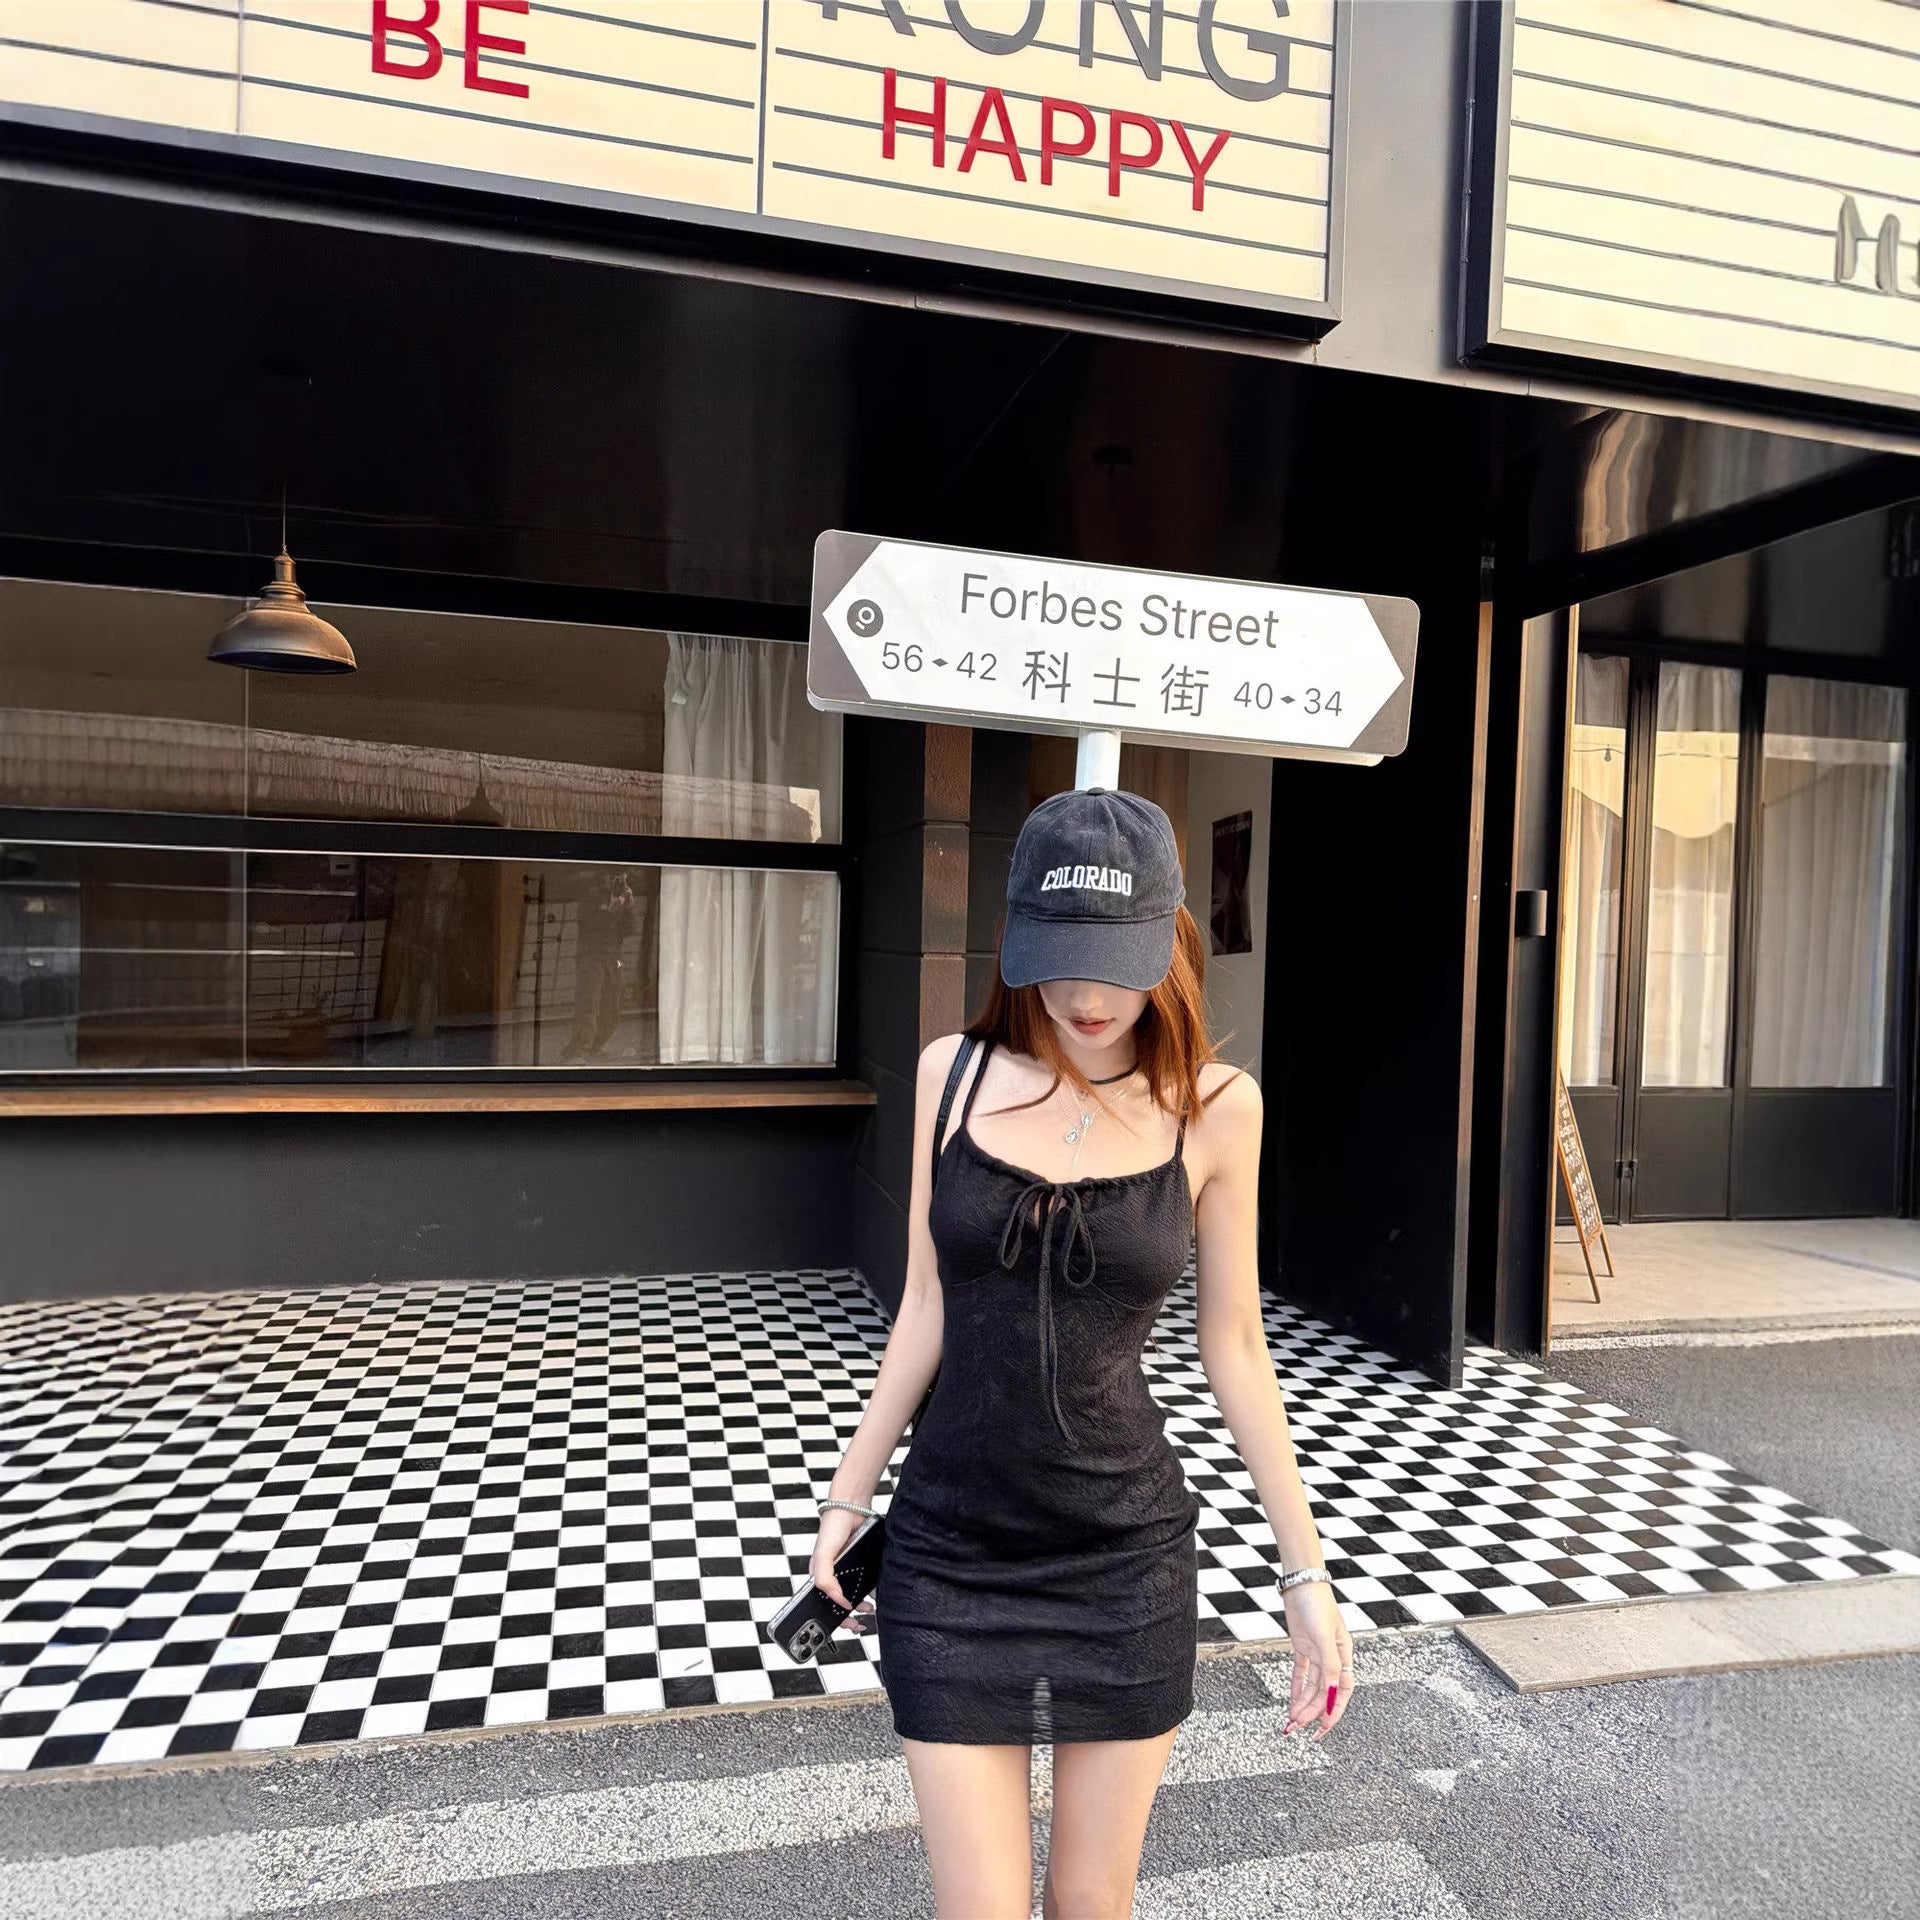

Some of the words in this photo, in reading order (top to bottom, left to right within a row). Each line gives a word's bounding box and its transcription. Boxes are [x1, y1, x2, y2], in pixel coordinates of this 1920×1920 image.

[371, 0, 529, 99] BE
[822, 0, 1290, 102] NG
[882, 67, 1232, 212] HAPPY
[961, 572, 1123, 631] Forbes
[1139, 594, 1279, 649] Street
[882, 641, 923, 673] 56
[956, 651, 997, 681] 42
[1022, 650, 1209, 717] 科士街
[1233, 681, 1273, 710] 40
[1304, 687, 1342, 717] 34
[1040, 865, 1133, 897] COLORADO
